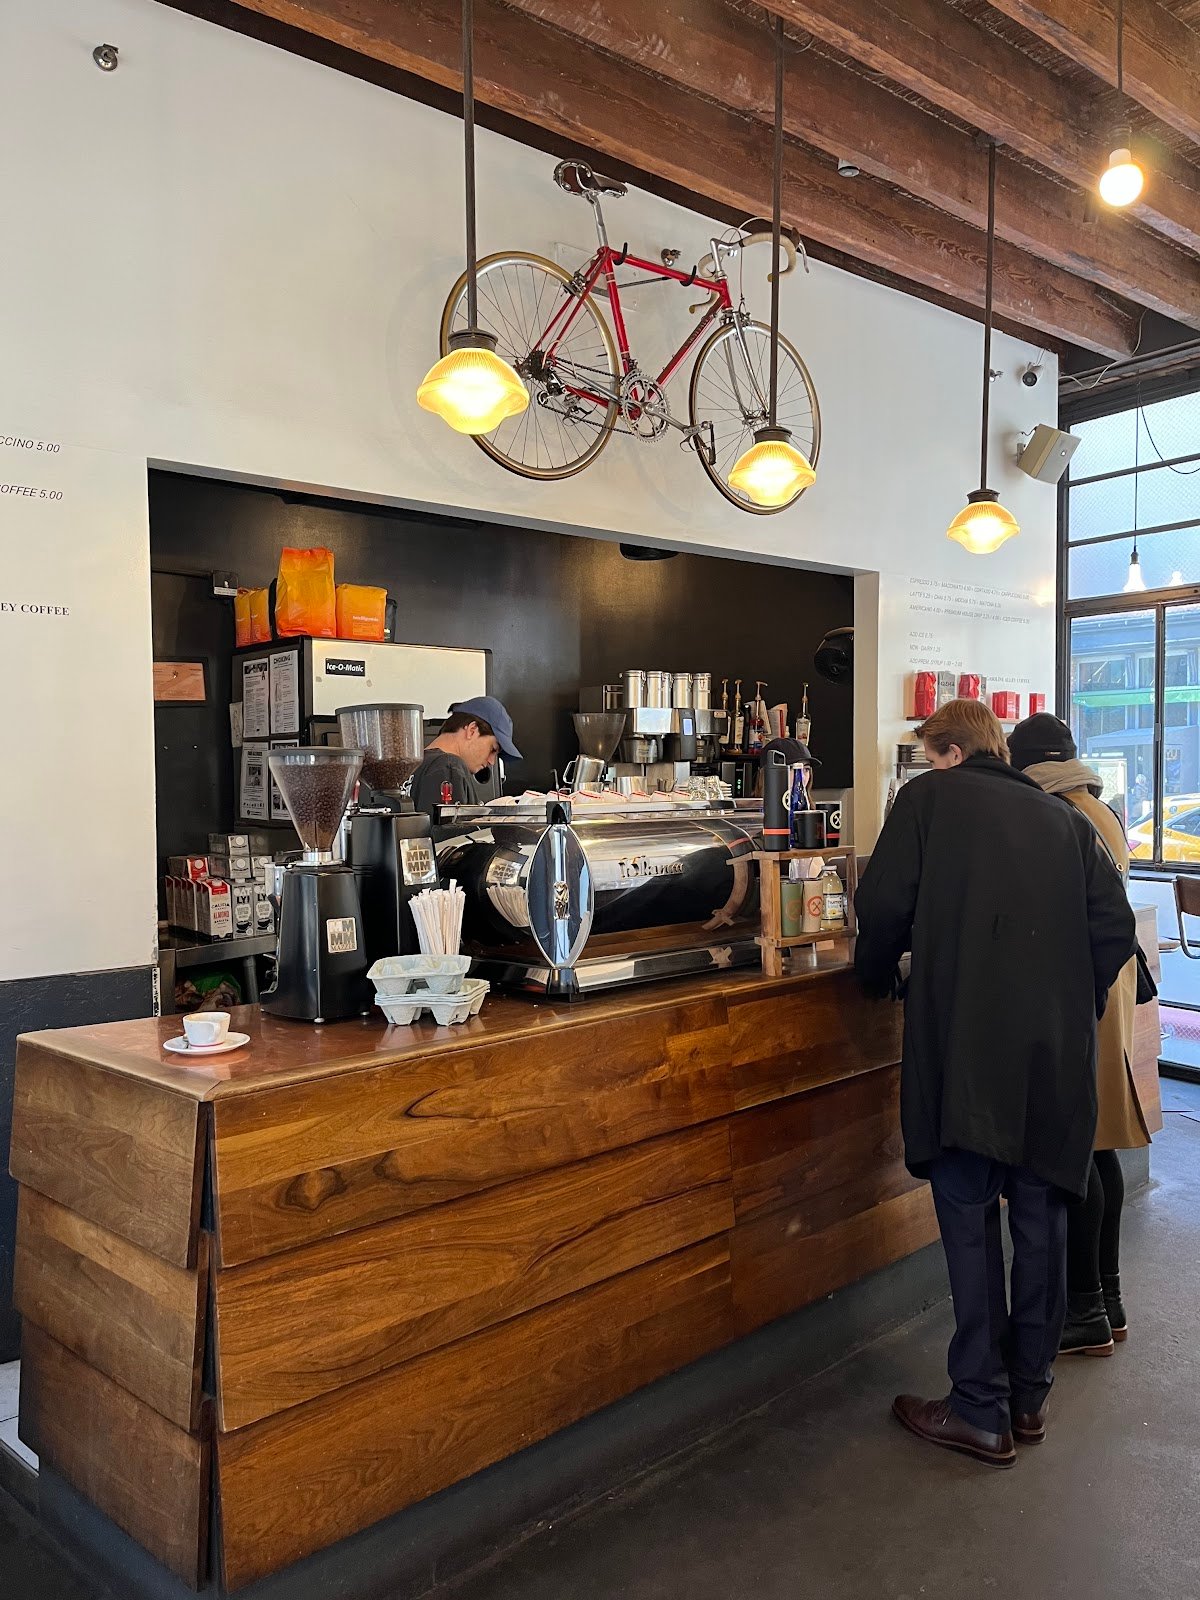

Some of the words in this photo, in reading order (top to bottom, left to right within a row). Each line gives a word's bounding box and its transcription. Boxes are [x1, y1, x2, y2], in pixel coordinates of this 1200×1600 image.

[0, 436, 34, 449] CCINO
[36, 441, 60, 453] 5.00
[0, 484, 38, 498] OFFEE
[40, 490, 63, 500] 5.00
[1, 602, 17, 612] EY
[21, 604, 70, 616] COFFEE
[326, 662, 364, 672] Ice-O-Matic
[213, 911, 229, 919] ALMOND
